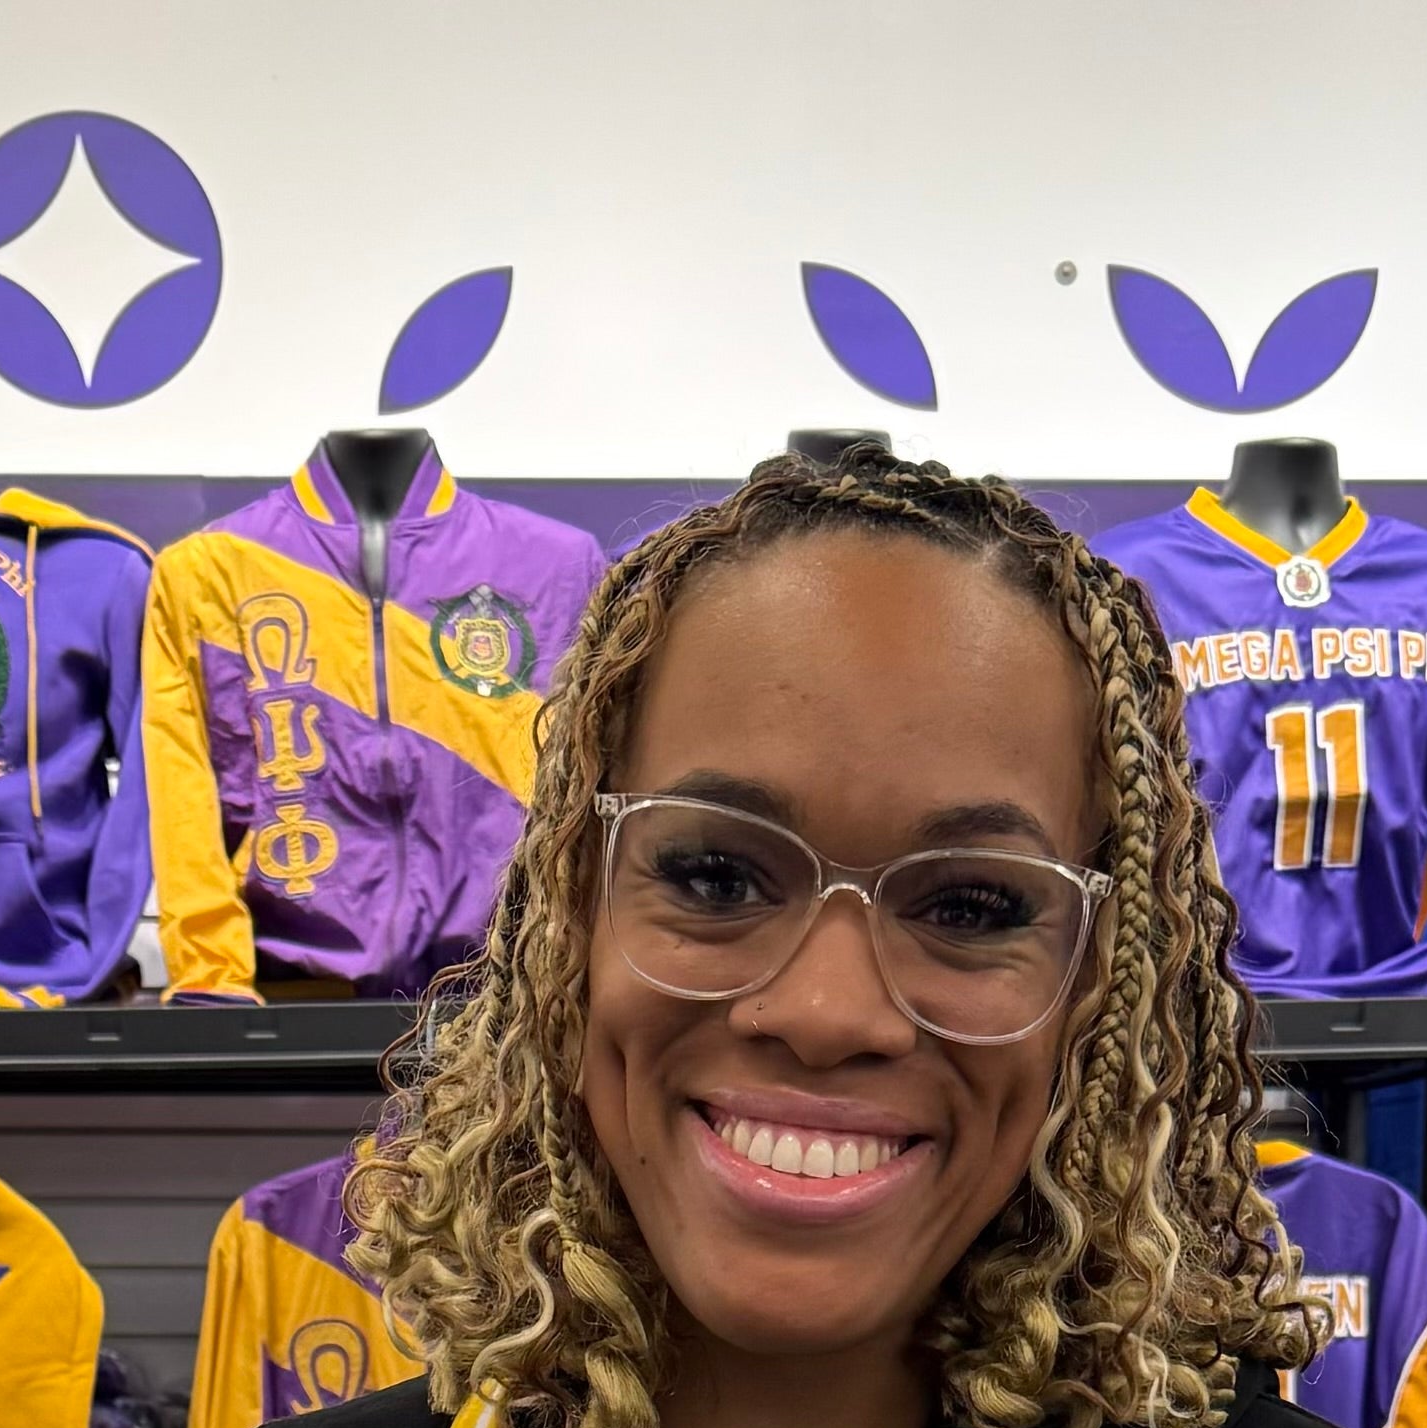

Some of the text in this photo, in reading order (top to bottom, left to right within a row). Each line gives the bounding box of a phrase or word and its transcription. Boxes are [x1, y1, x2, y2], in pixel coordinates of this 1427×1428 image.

[1174, 628, 1305, 692] MEGA
[1311, 628, 1391, 681] PSI
[1265, 700, 1368, 871] 11
